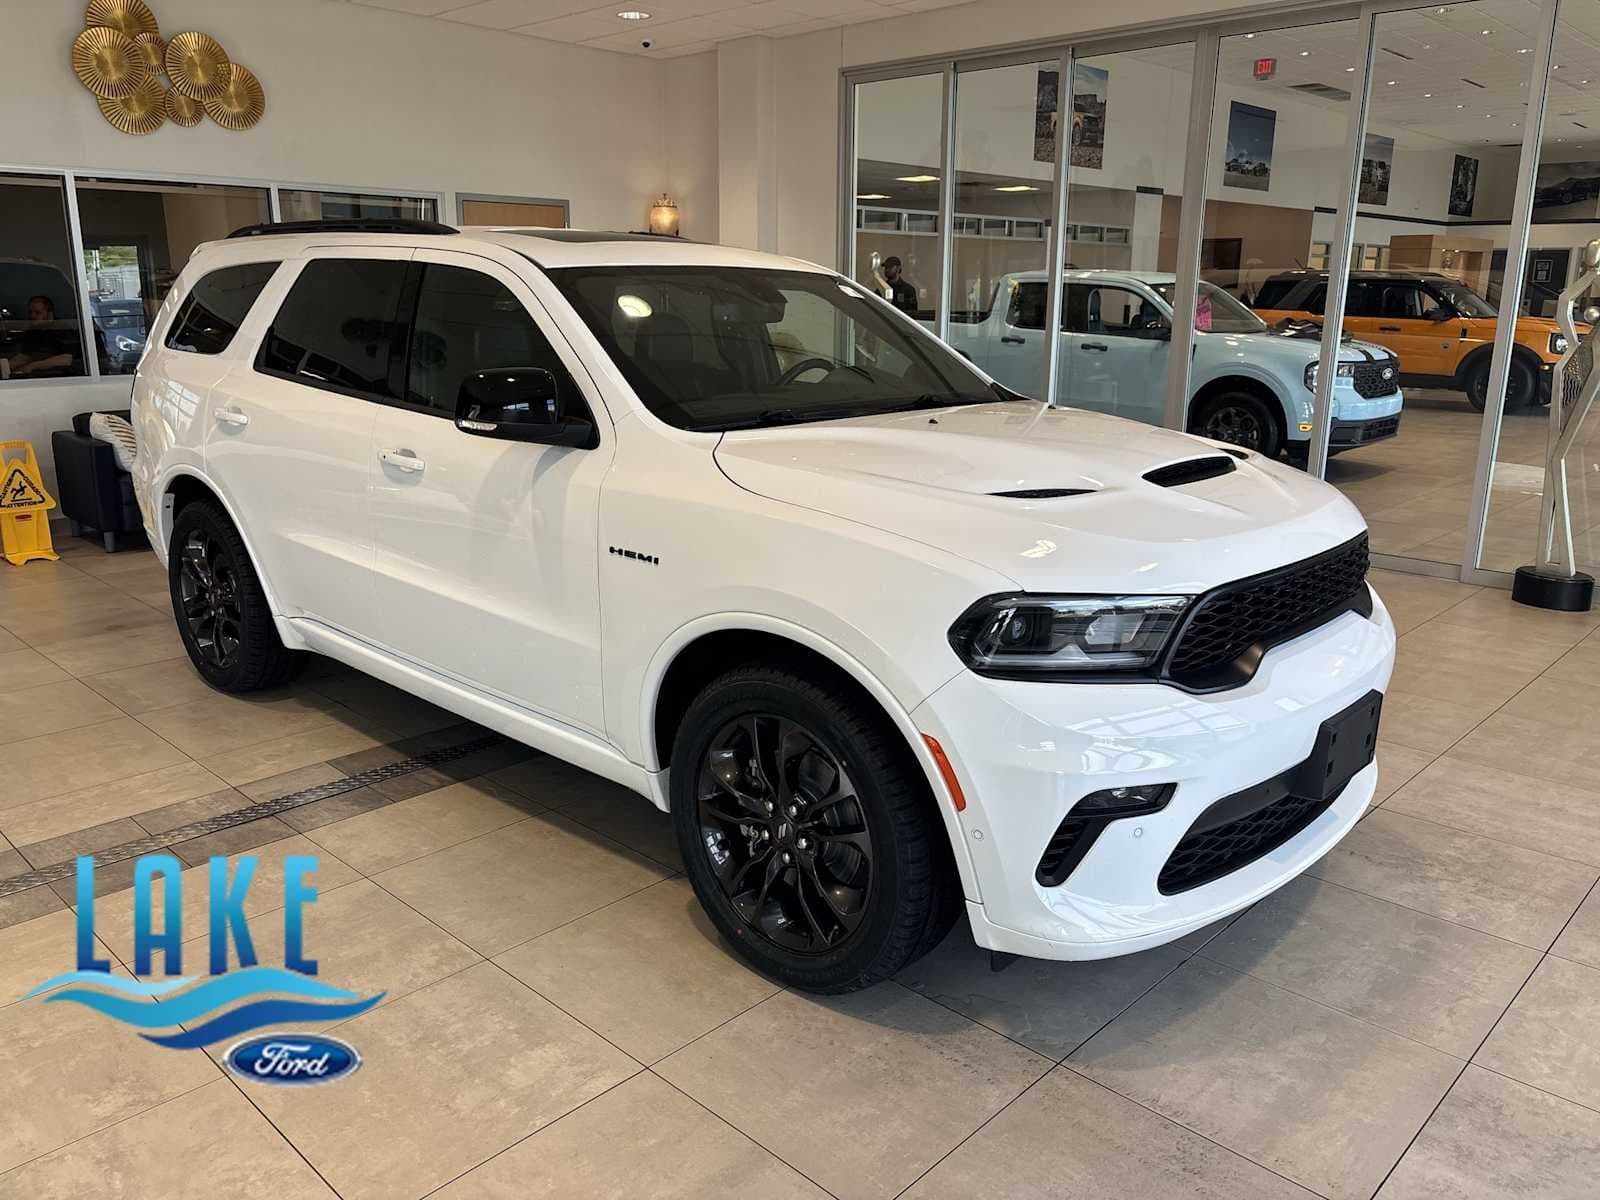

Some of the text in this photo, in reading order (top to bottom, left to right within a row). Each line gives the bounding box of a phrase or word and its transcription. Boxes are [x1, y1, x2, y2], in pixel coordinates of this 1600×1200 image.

[1257, 60, 1273, 74] EXIT
[7, 500, 37, 509] ATTENTION
[609, 546, 660, 565] HEMI
